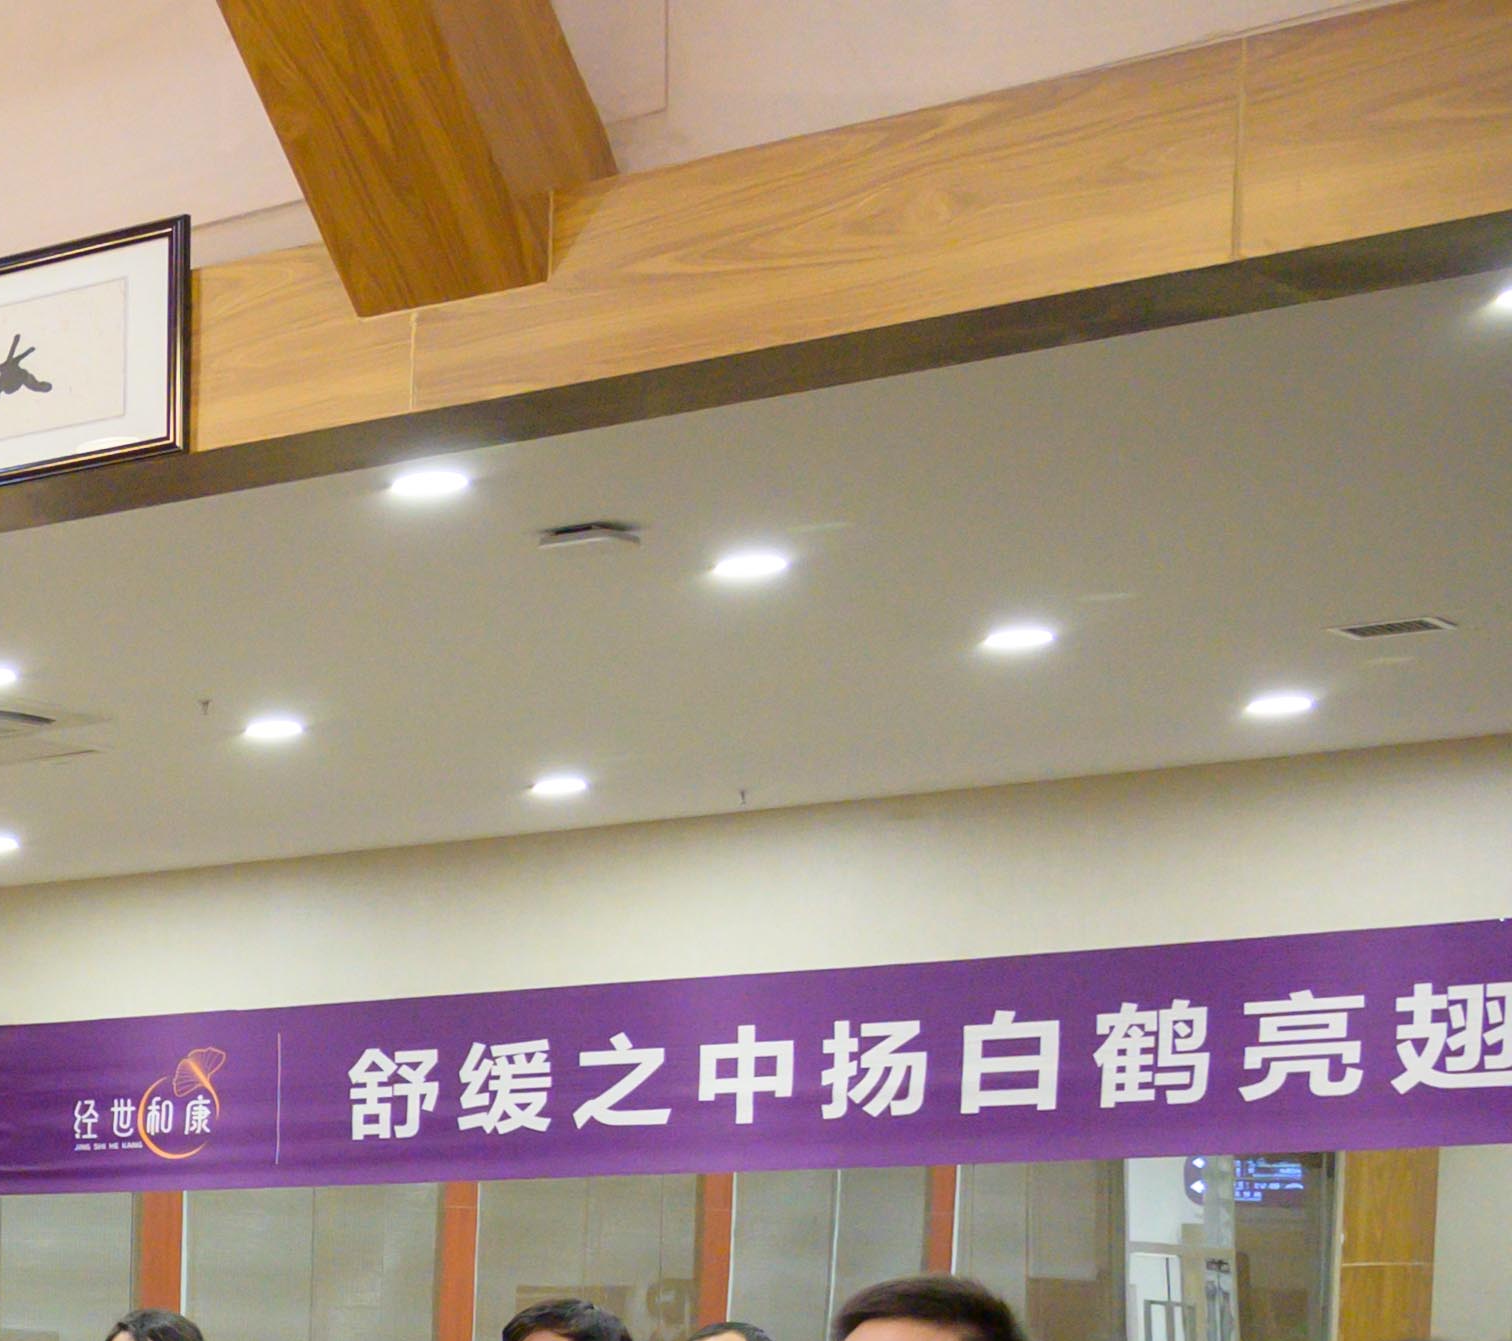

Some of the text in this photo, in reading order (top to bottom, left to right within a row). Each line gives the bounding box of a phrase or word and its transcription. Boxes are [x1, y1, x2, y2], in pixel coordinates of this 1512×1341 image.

[347, 981, 1512, 1141] 舒缓之中扬白鹤亮翅
[73, 1094, 211, 1140] 经世和康
